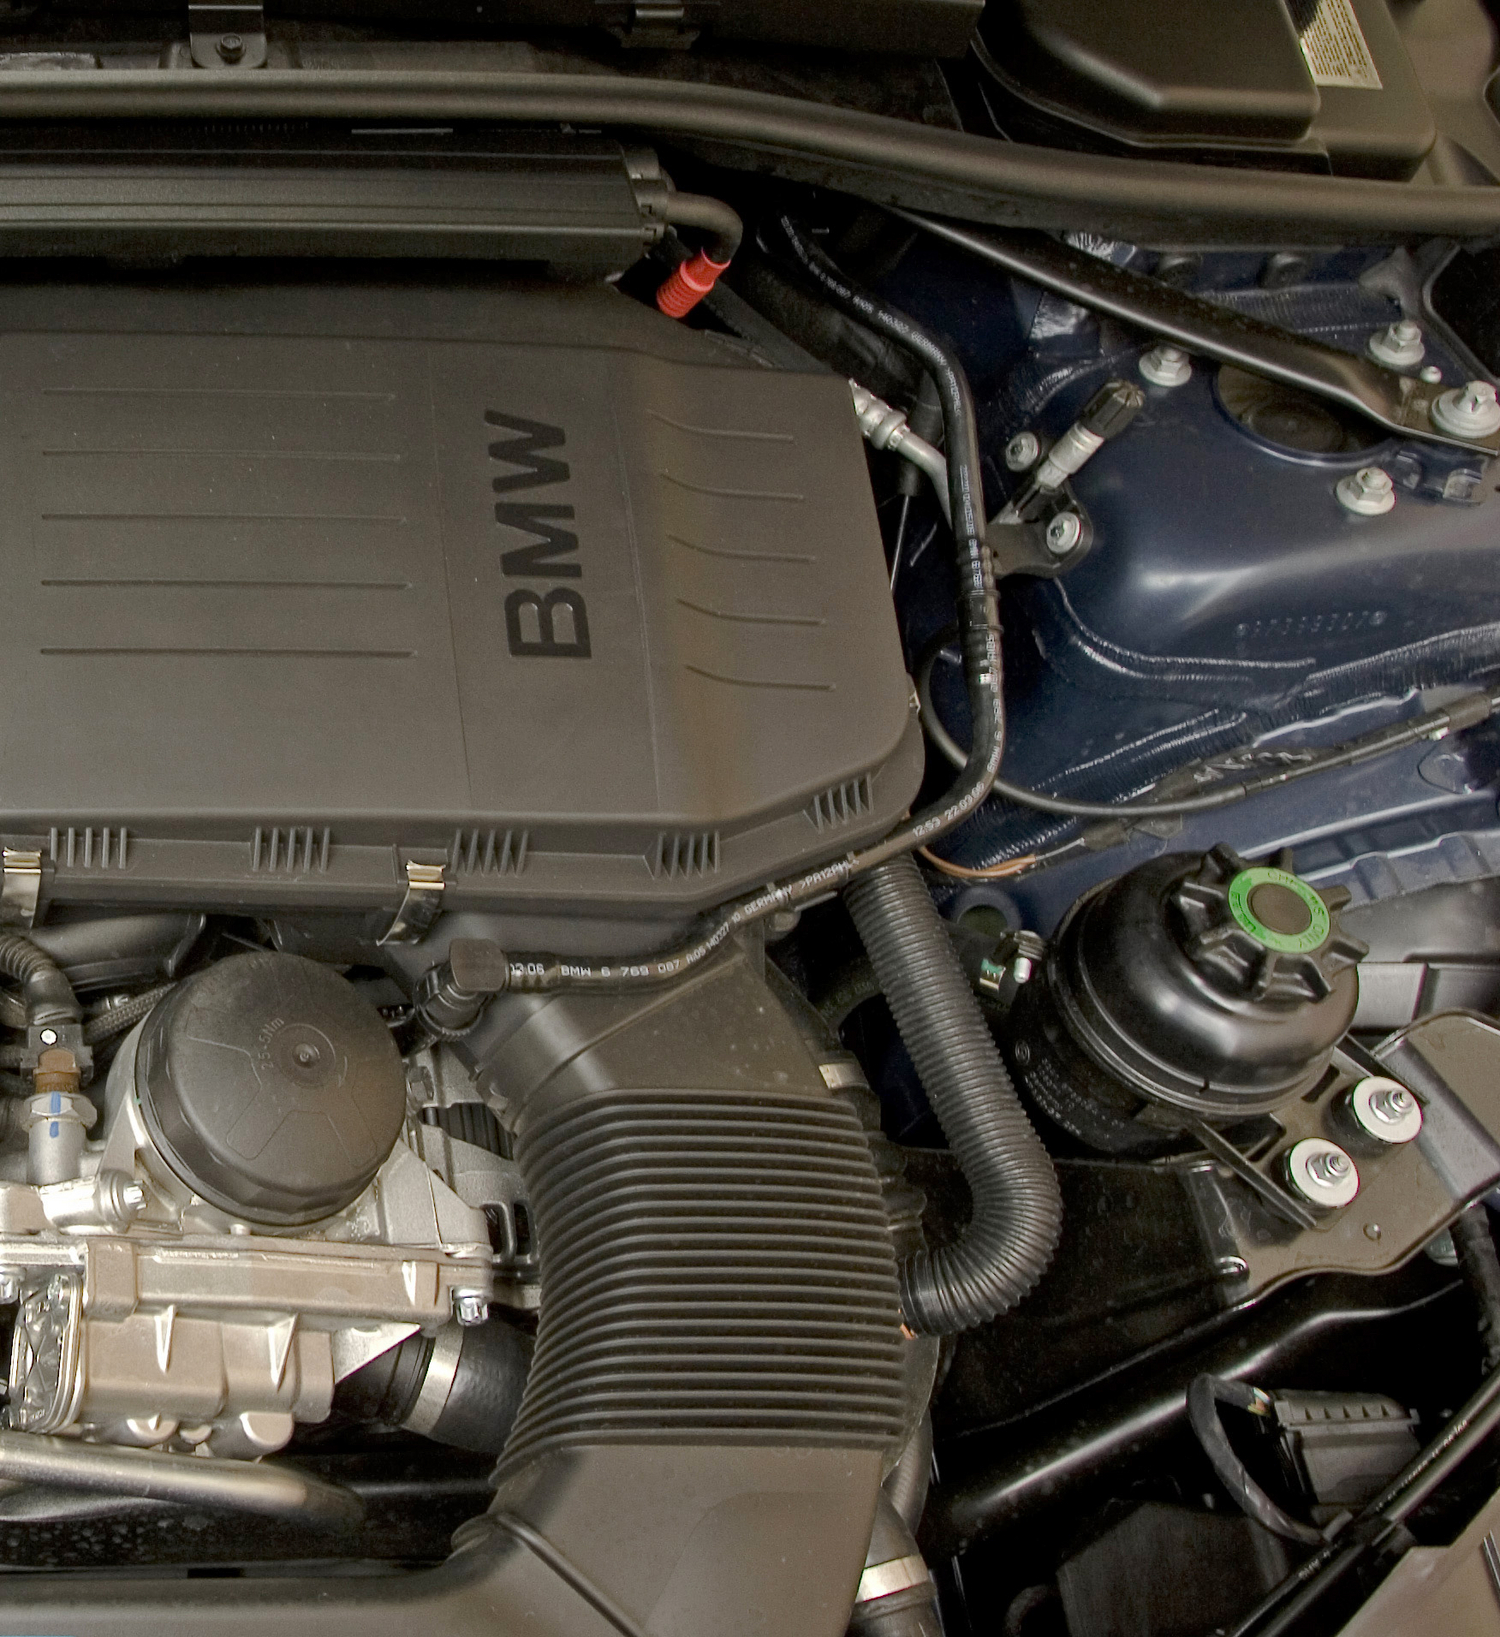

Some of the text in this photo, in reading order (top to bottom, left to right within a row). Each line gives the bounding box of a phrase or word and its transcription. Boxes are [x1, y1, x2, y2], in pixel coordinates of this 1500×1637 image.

[911, 331, 948, 367] GERMANY
[484, 409, 592, 659] BMW
[987, 745, 1001, 773] BMW
[561, 964, 592, 977] BMW
[601, 966, 611, 978] 6
[744, 884, 793, 915] GERMANY
